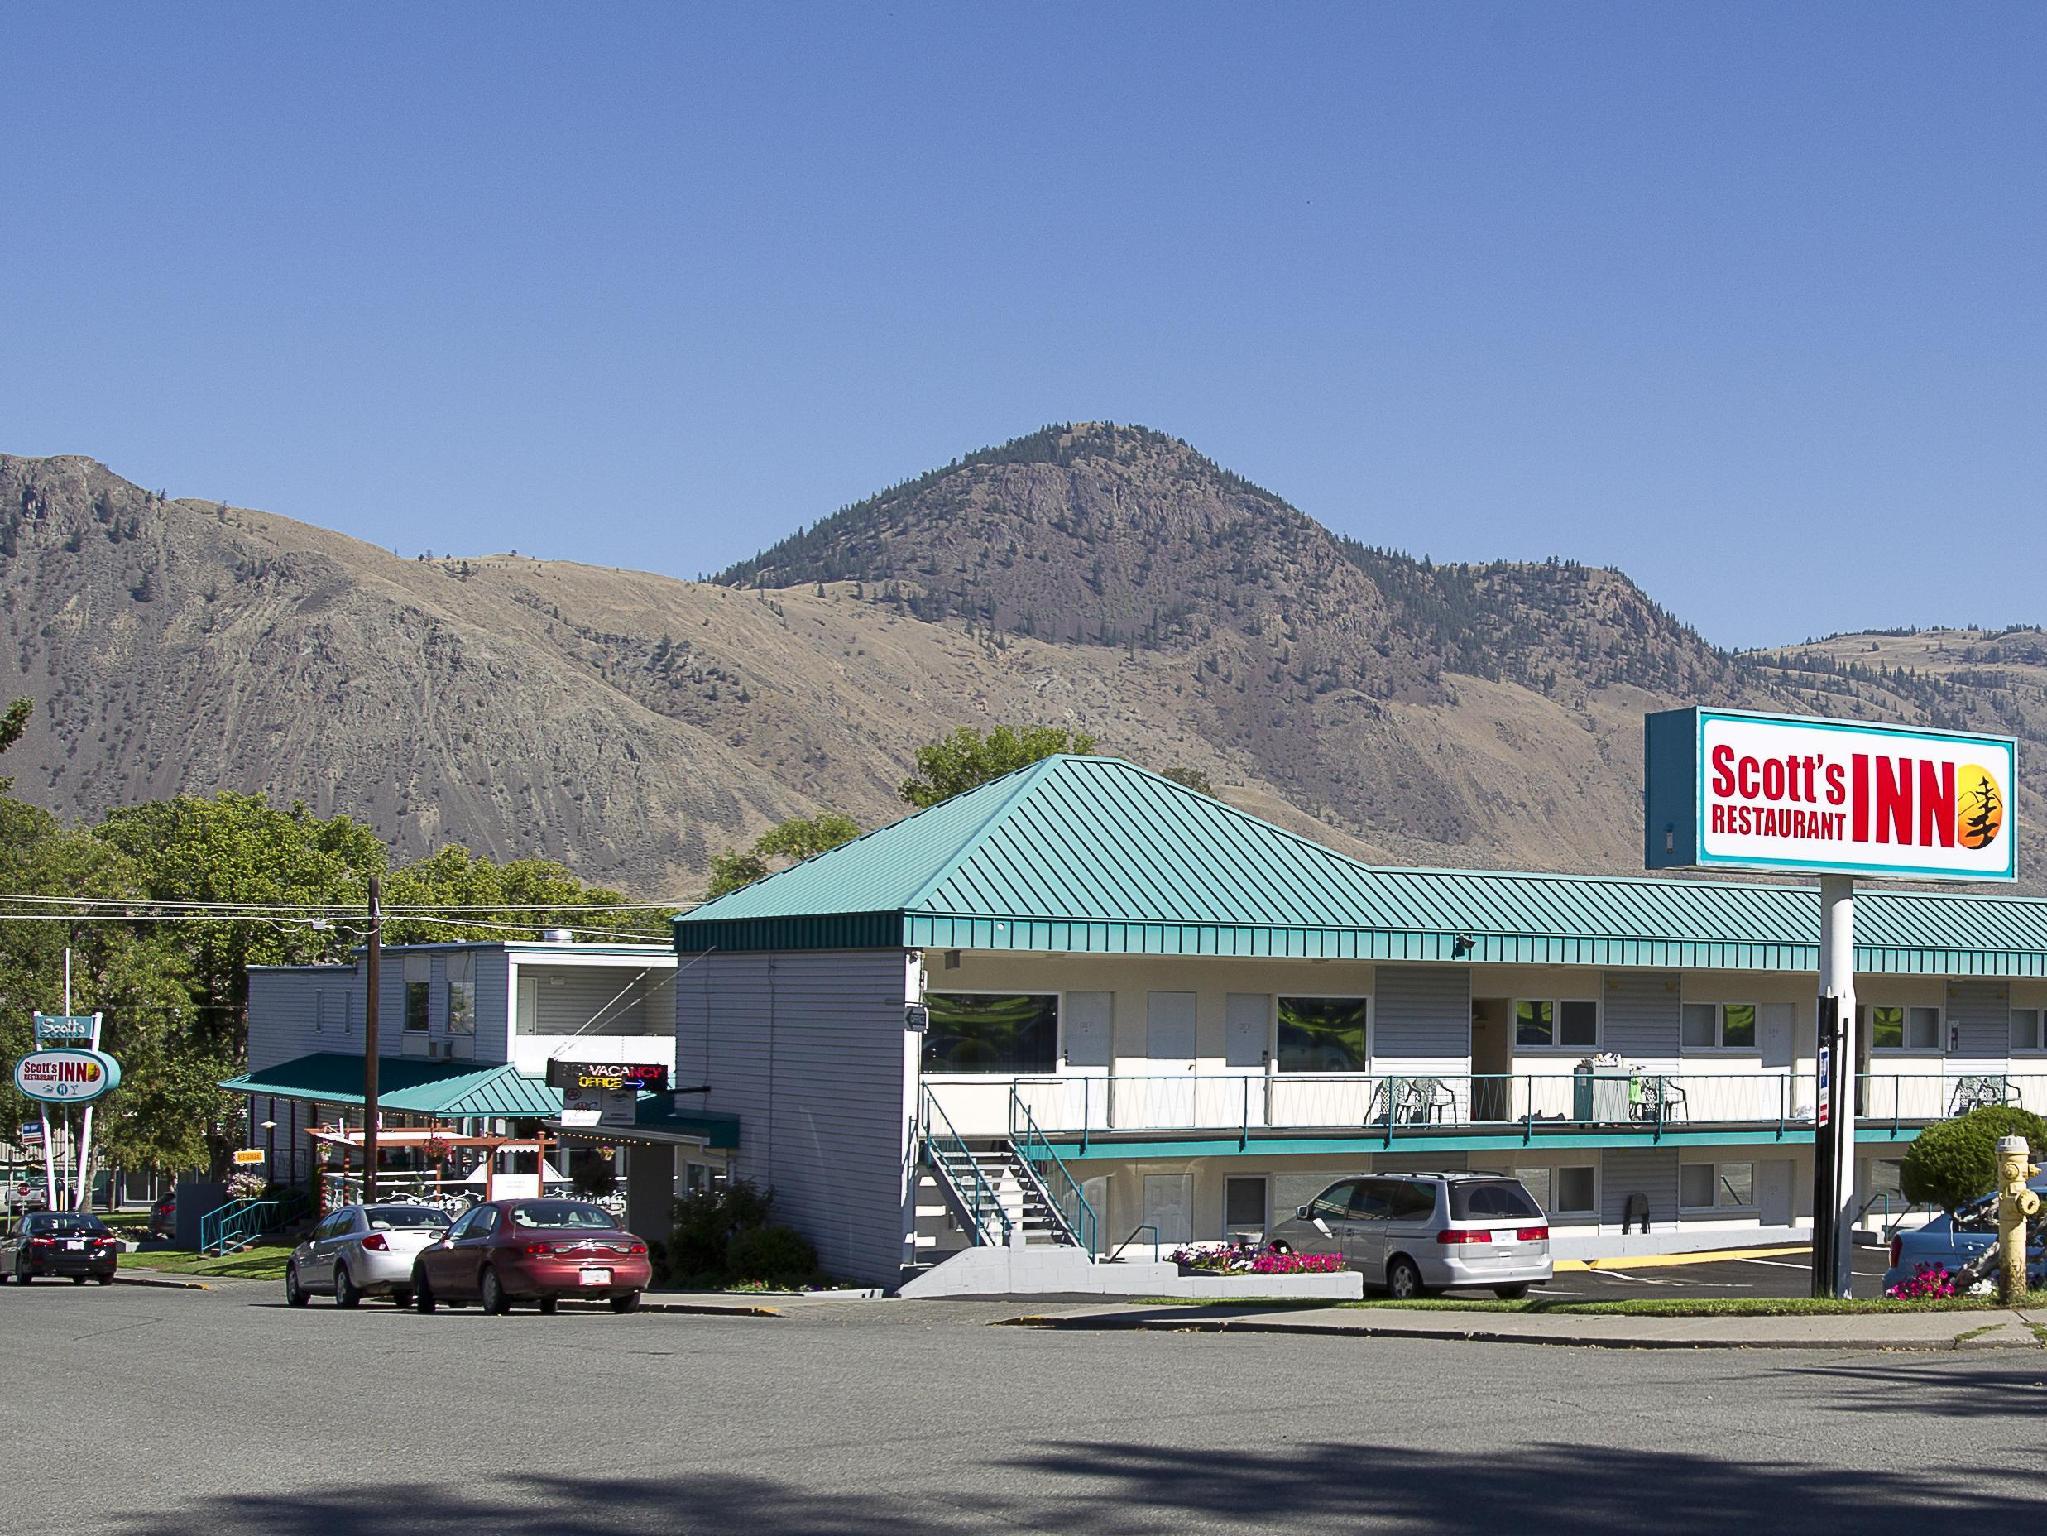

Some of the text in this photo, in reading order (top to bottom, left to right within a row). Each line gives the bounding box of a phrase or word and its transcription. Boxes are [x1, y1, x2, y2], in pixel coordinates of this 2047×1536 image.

[1712, 744, 1846, 805] Scott's
[1852, 753, 1955, 848] INN
[1712, 803, 1847, 842] RESTAURANT
[58, 1062, 87, 1082] INN
[578, 1076, 622, 1088] OFFICE
[589, 1064, 661, 1078] VACANCY
